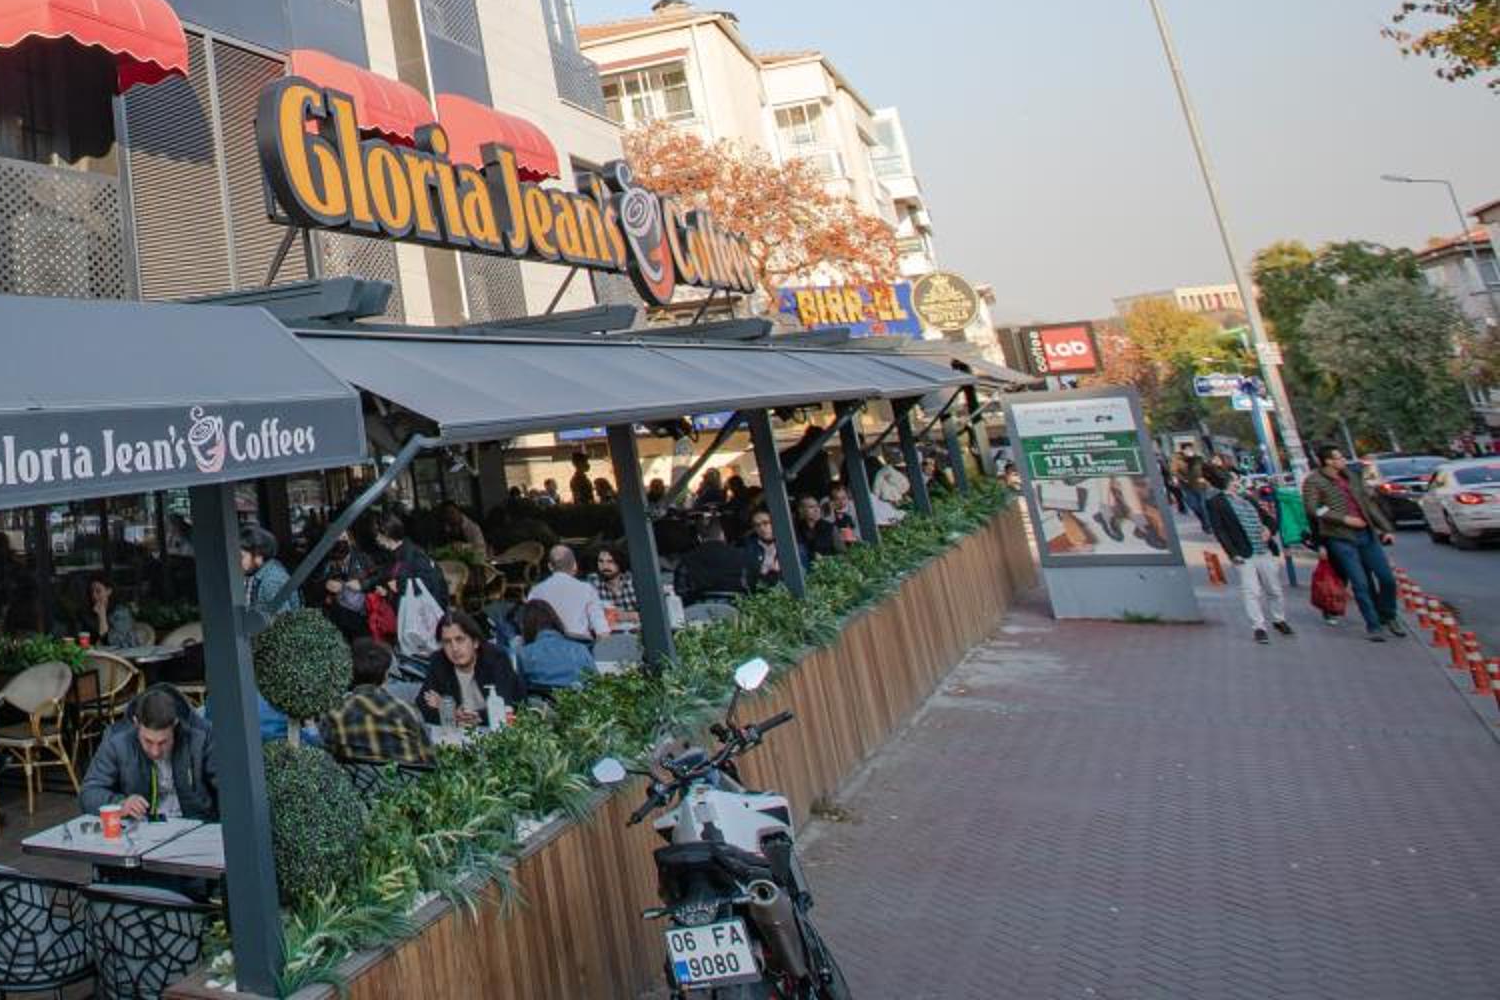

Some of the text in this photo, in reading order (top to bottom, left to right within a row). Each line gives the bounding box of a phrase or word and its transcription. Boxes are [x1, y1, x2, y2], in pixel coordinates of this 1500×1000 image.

[268, 78, 500, 250] Gloria
[498, 143, 628, 268] Jean's
[101, 425, 187, 476] Jean's
[229, 417, 316, 462] Coffees
[1043, 454, 1073, 468] 175
[671, 924, 744, 953] 06 FA
[689, 952, 740, 978] 9080
